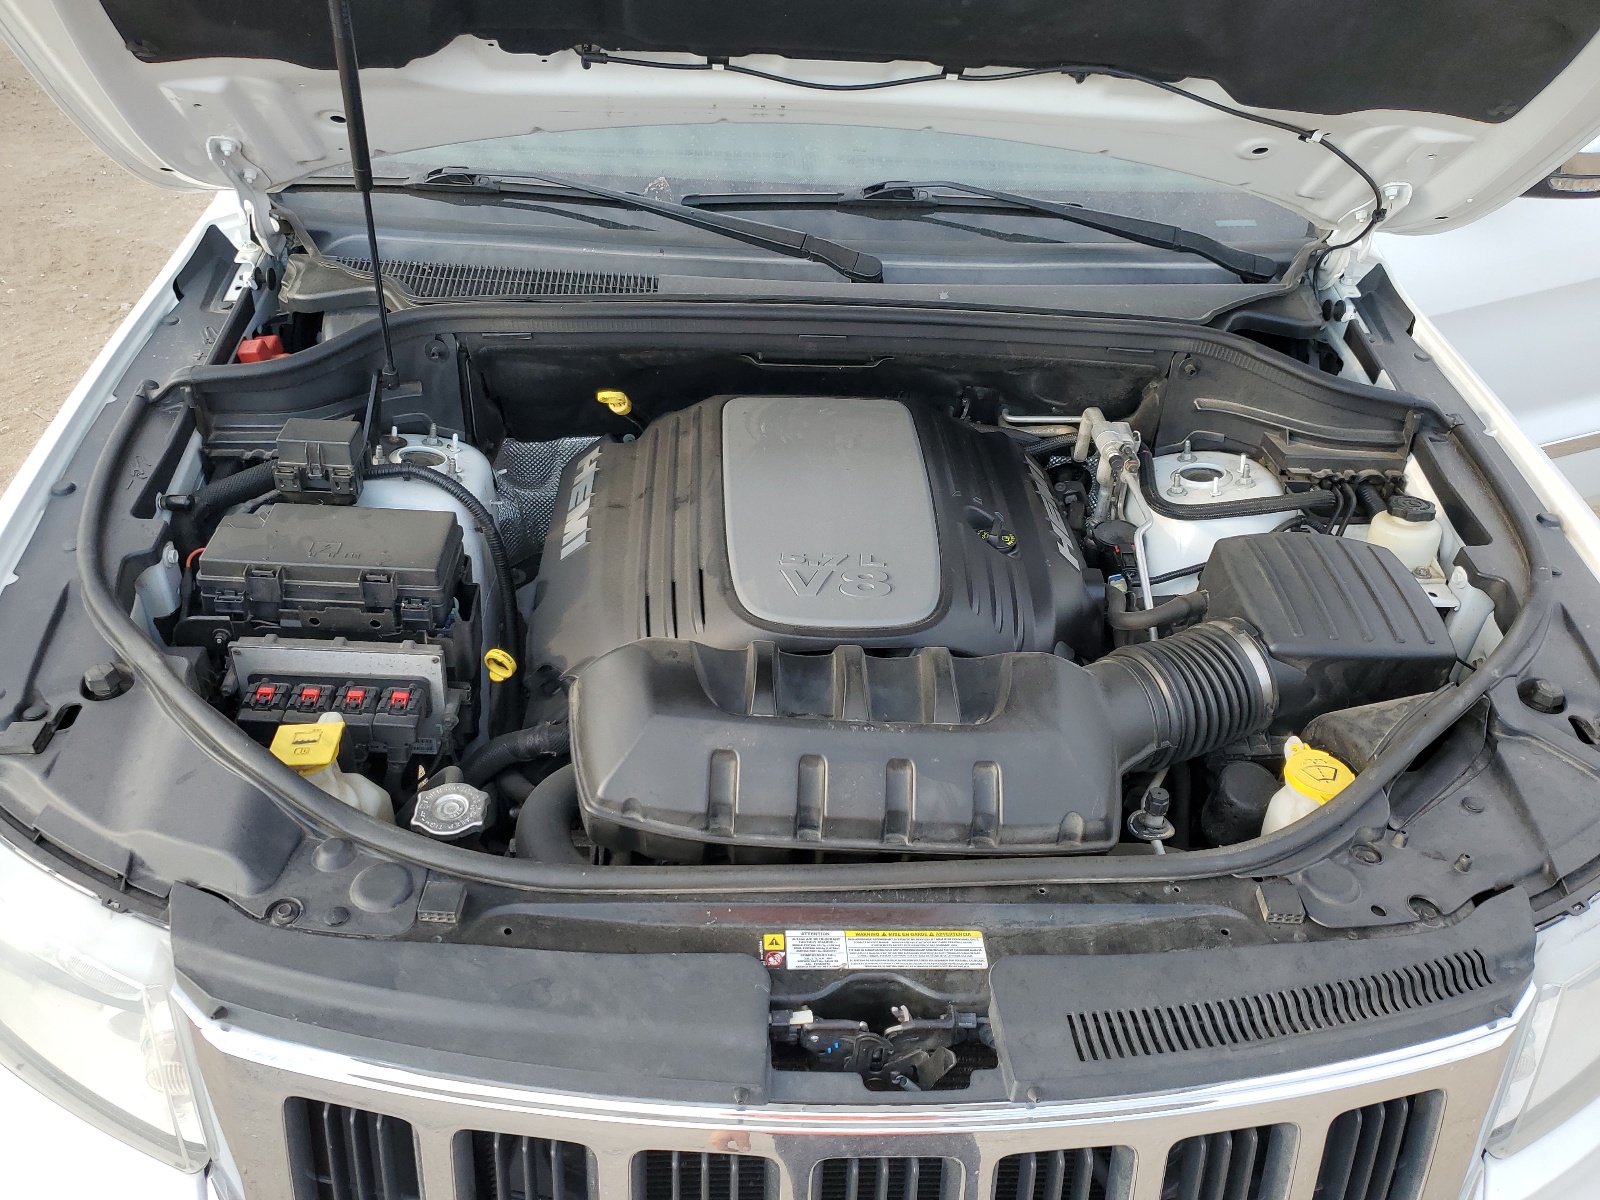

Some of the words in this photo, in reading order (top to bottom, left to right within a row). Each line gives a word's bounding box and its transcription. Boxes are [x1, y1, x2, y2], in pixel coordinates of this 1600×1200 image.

[560, 446, 602, 560] HEMI
[1024, 454, 1081, 572] HEMI
[779, 568, 893, 598] V8
